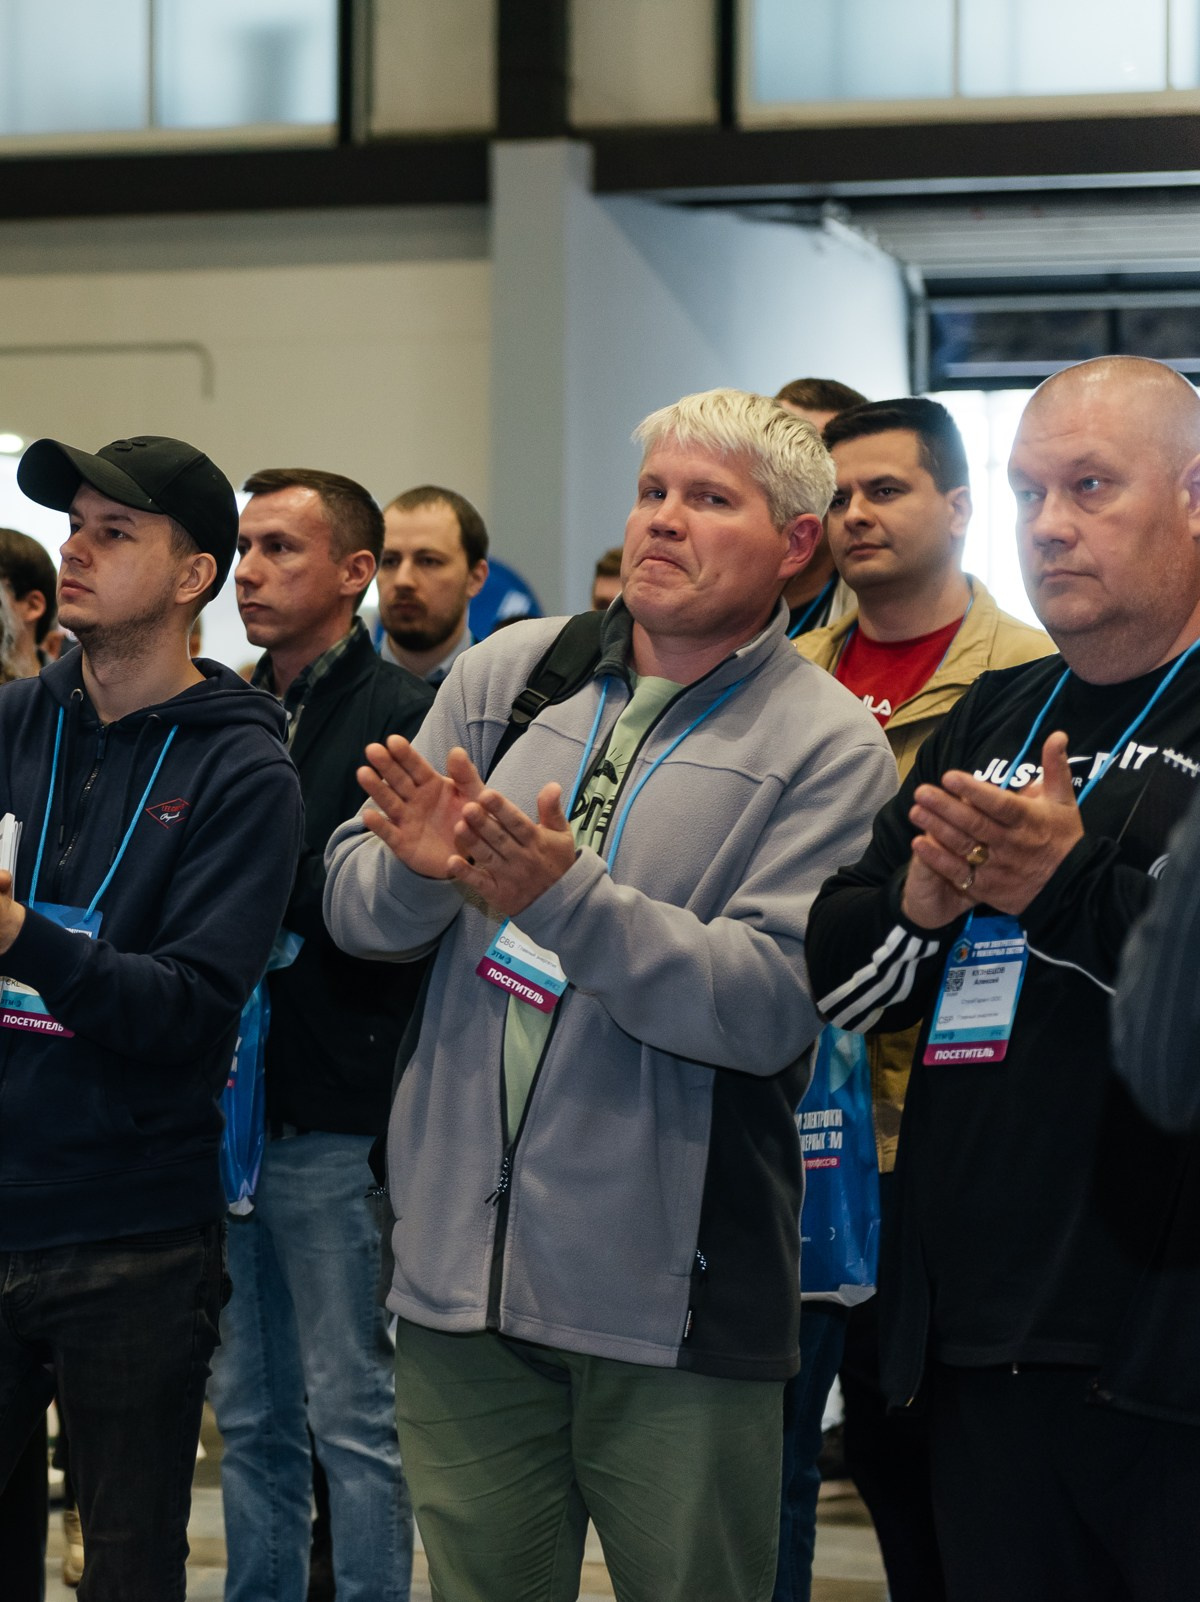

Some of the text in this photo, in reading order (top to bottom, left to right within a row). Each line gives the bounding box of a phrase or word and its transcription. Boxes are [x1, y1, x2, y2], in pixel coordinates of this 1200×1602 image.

[860, 694, 892, 716] ILA
[1118, 741, 1159, 770] IT
[499, 936, 516, 949] CBG
[491, 950, 505, 960] ЭТМ
[487, 967, 544, 1005] ПОСЕТИТЕЛЬ
[3, 1015, 64, 1032] ПОСЕТИТЕЛЬ
[934, 1047, 995, 1060] ПОСЕТИТЕЛЬ
